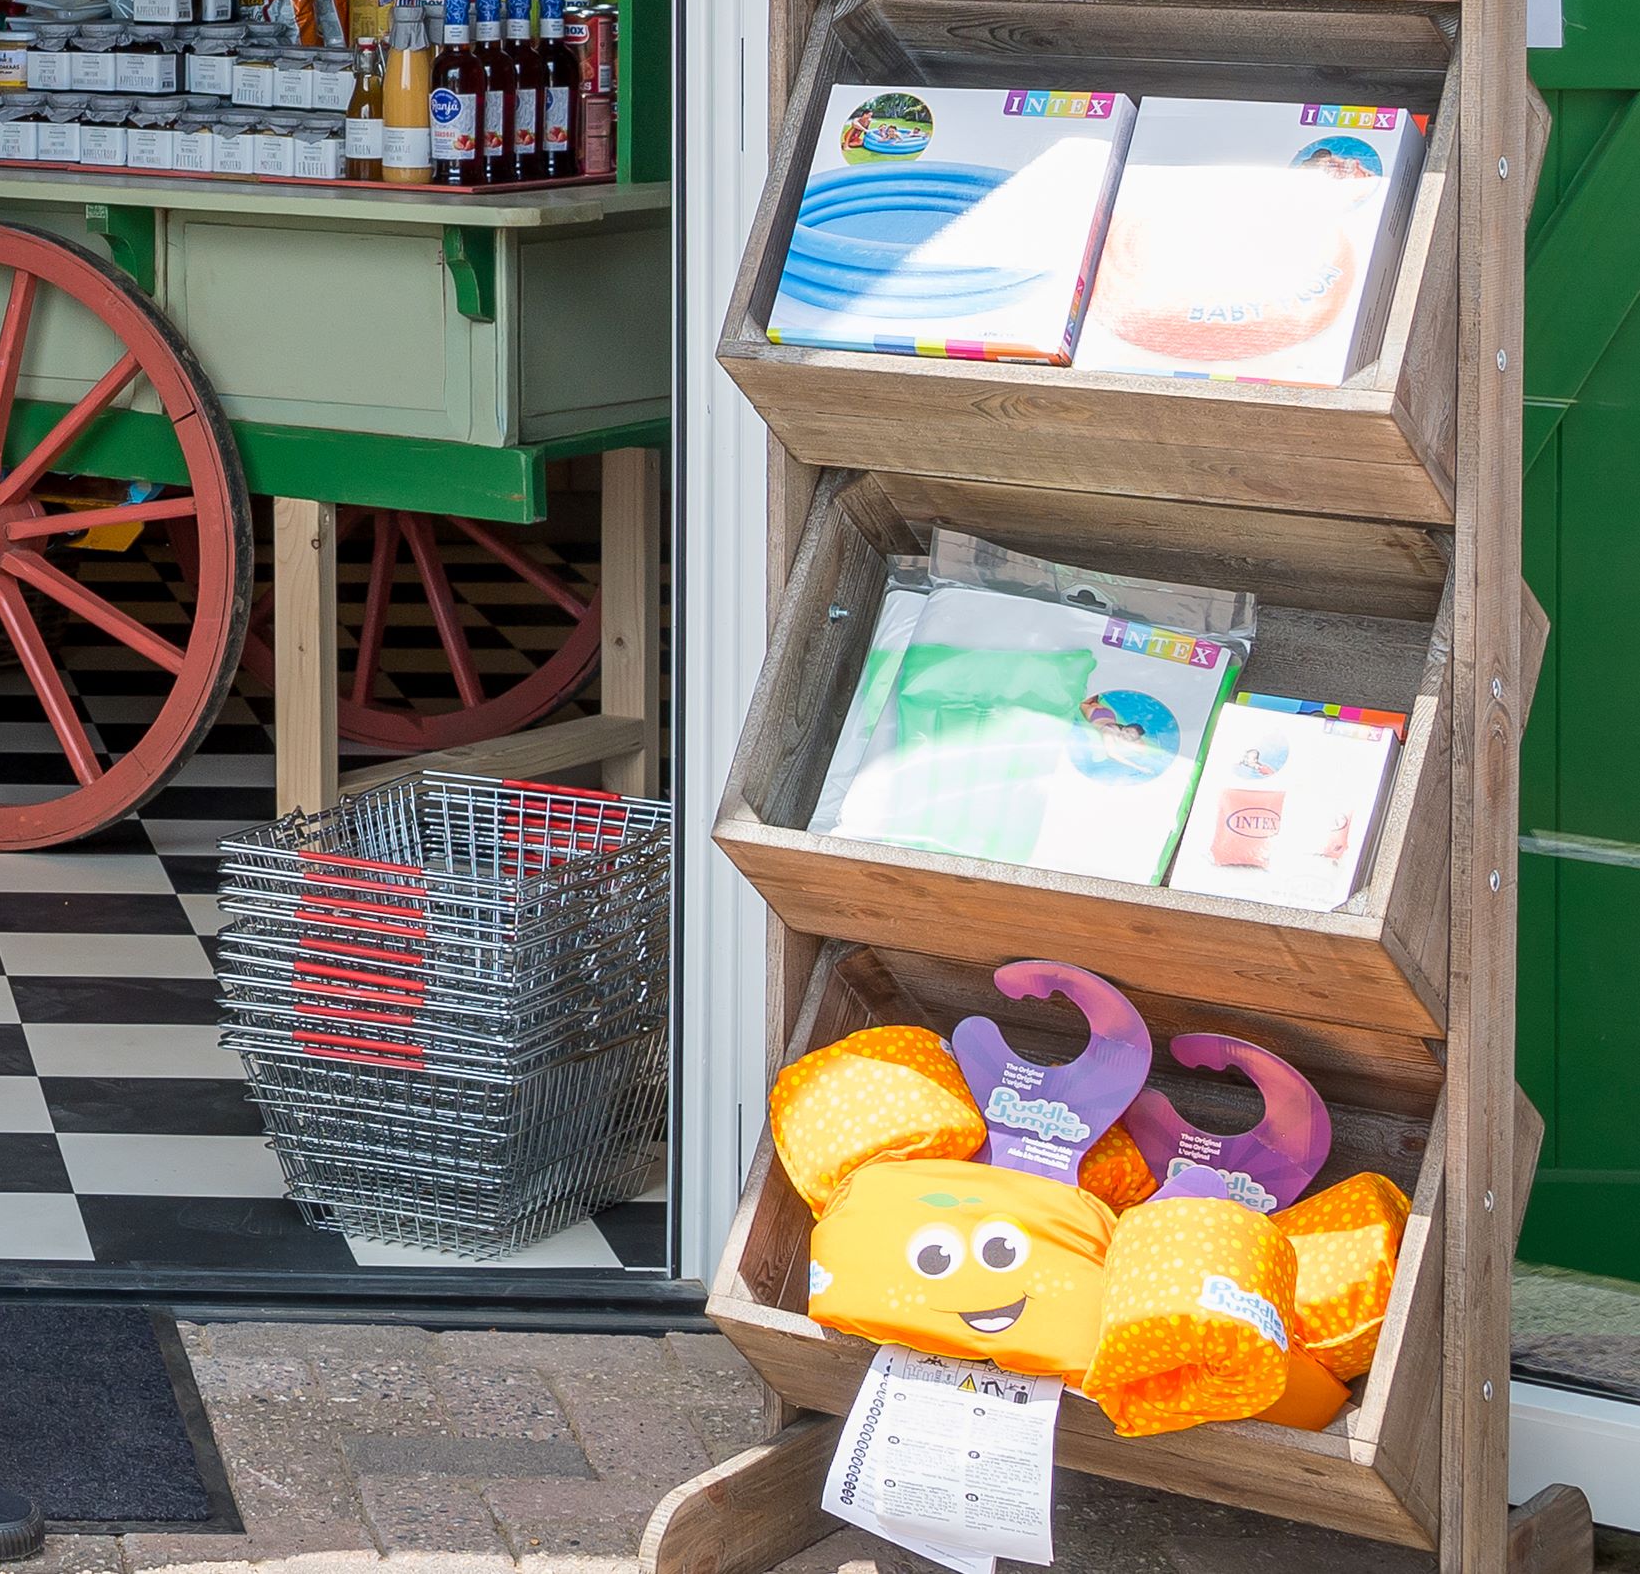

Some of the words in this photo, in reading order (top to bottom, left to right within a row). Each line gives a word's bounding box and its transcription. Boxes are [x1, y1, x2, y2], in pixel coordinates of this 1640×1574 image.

[565, 25, 585, 35] nox
[1008, 96, 1110, 116] INTEX
[1304, 107, 1394, 128] INTEX
[1111, 626, 1212, 667] INTEX
[1235, 815, 1278, 831] INTEX
[1016, 1073, 1042, 1086] Original
[1018, 1065, 1045, 1079] Original
[993, 1091, 1075, 1125] Puddle
[988, 1104, 1087, 1137] Jumper
[1181, 1133, 1194, 1142] The
[1194, 1135, 1222, 1148] Original
[1192, 1143, 1221, 1155] Original
